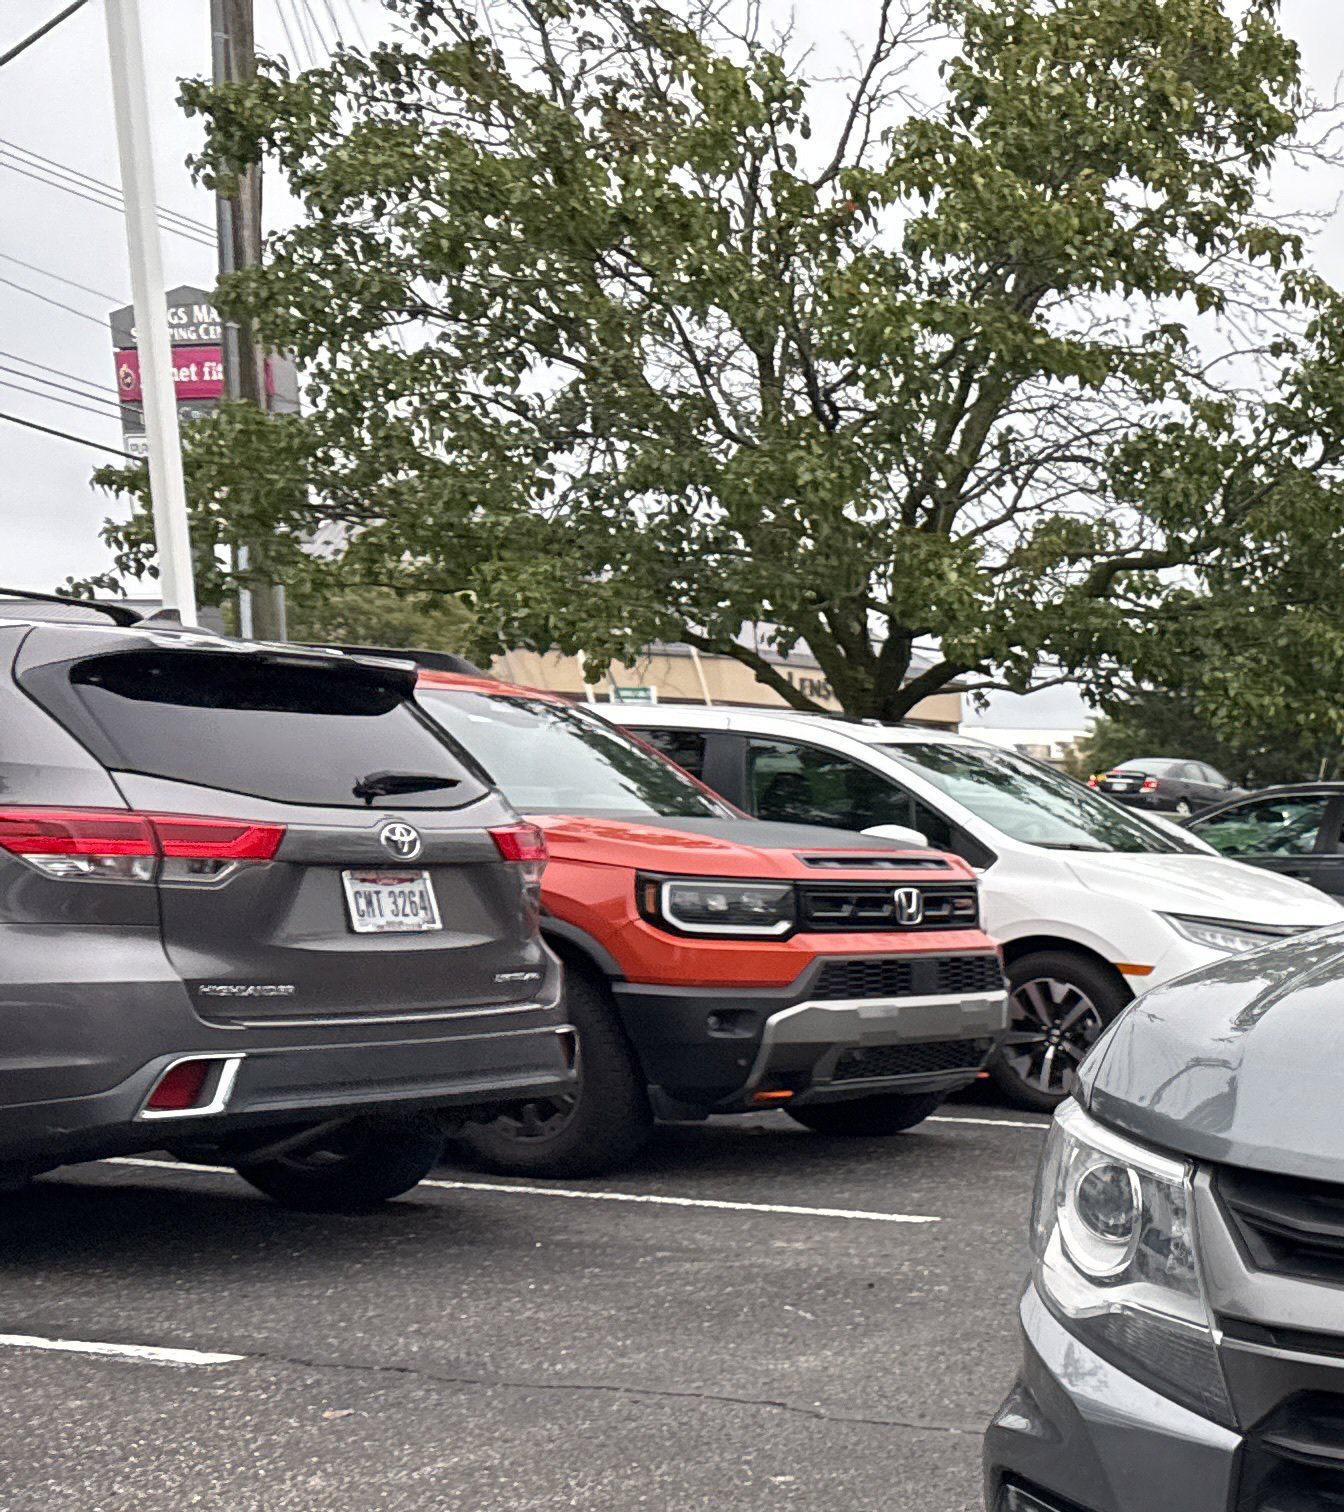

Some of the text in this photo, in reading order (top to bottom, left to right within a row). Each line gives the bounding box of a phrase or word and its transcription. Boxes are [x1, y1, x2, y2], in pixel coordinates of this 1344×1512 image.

[193, 304, 222, 323] MA
[203, 361, 224, 381] fit
[388, 890, 430, 918] 3264
